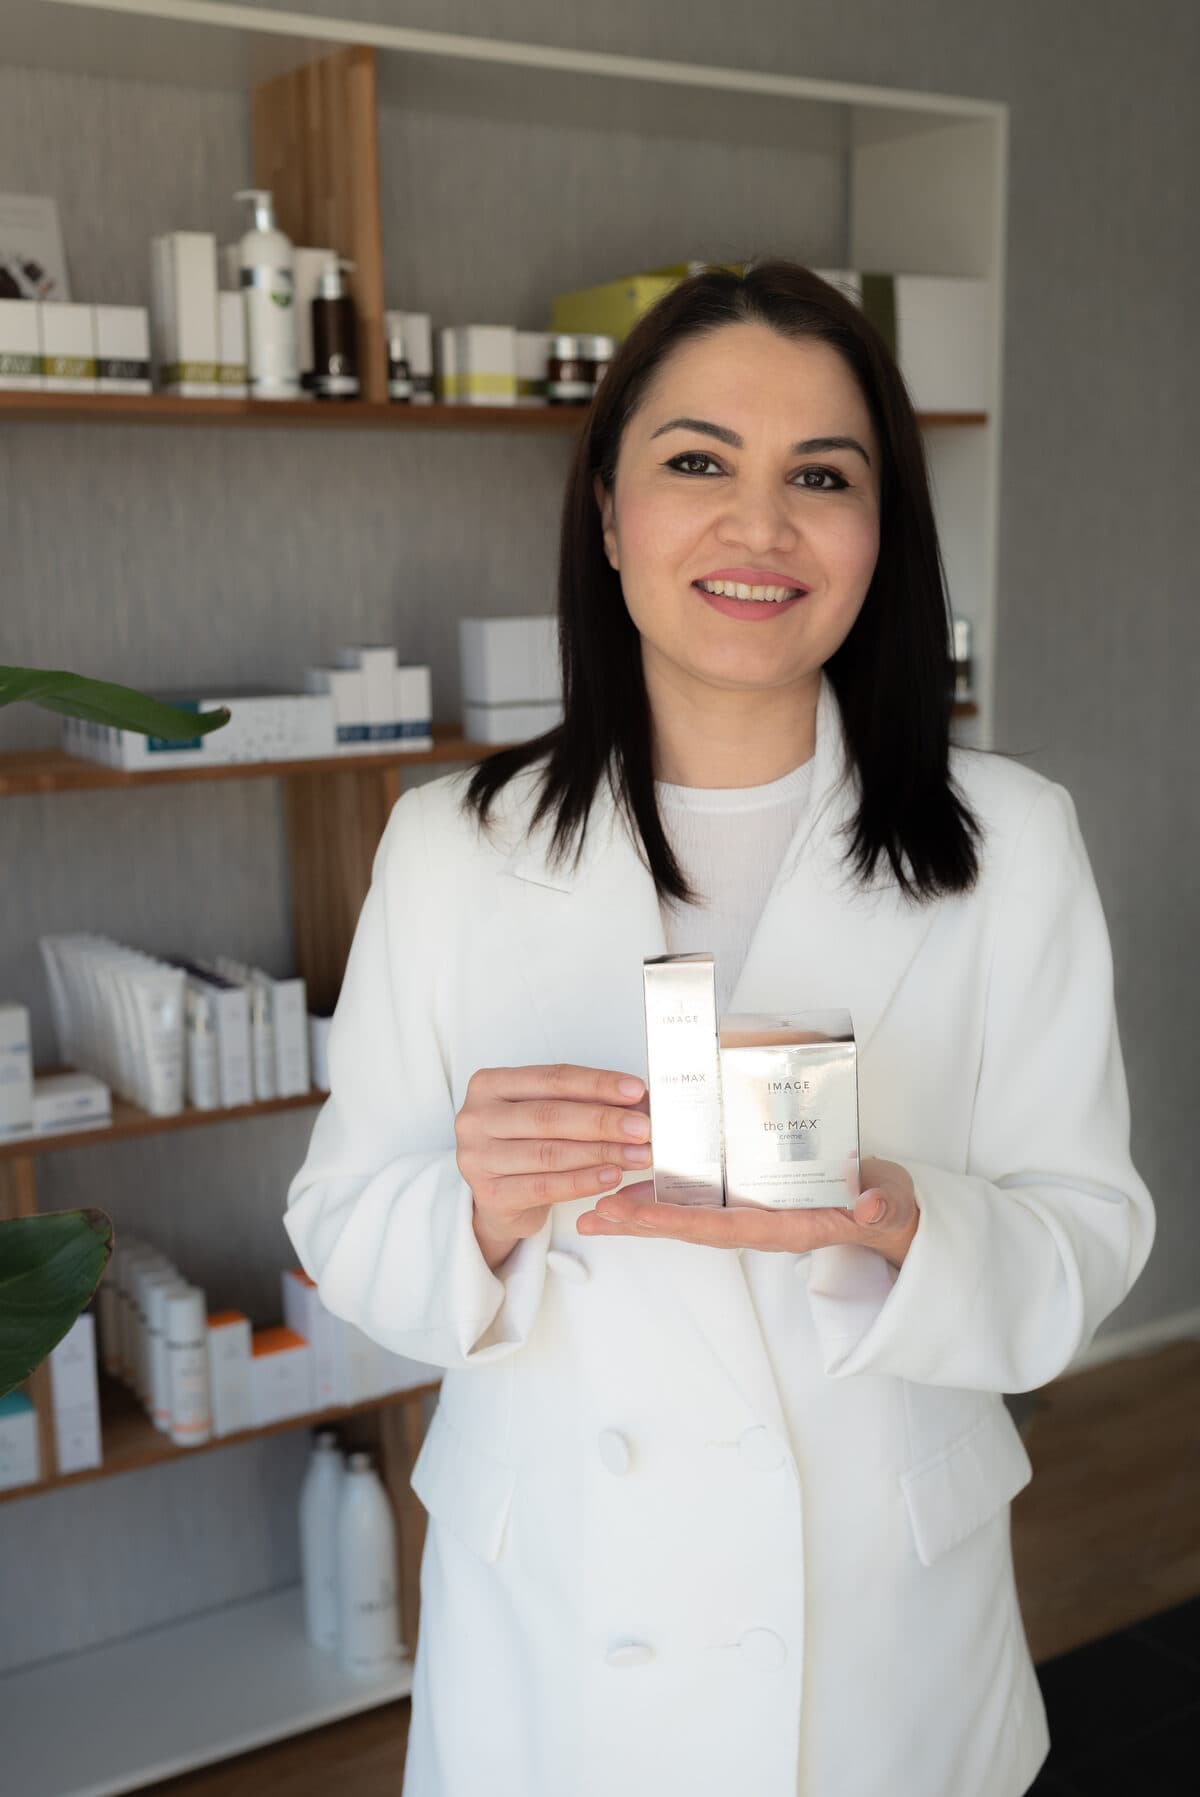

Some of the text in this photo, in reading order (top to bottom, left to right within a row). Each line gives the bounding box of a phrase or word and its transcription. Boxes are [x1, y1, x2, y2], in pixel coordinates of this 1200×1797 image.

[662, 1015, 698, 1024] IMAGE
[681, 1073, 706, 1083] MAX
[768, 1081, 810, 1091] IMAGE
[763, 1120, 784, 1131] the
